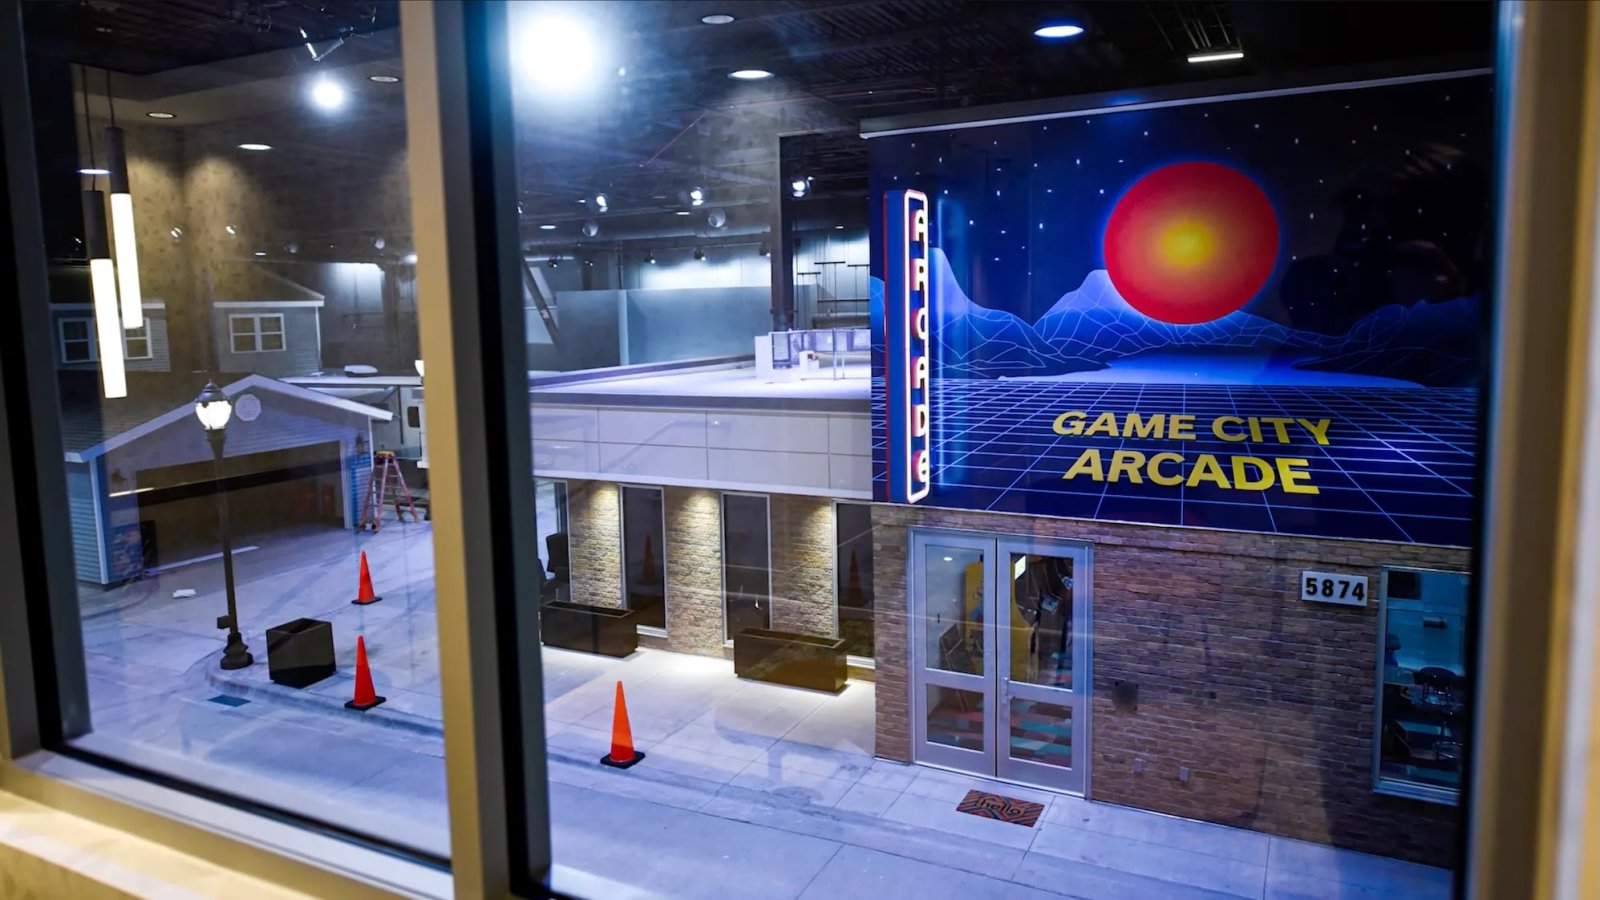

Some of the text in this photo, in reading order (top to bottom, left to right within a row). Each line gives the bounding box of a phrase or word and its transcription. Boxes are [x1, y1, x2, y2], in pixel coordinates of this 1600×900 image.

[1052, 411, 1331, 445] GAME CITY
[1062, 448, 1320, 494] ARCADE
[1306, 577, 1364, 601] 5874
